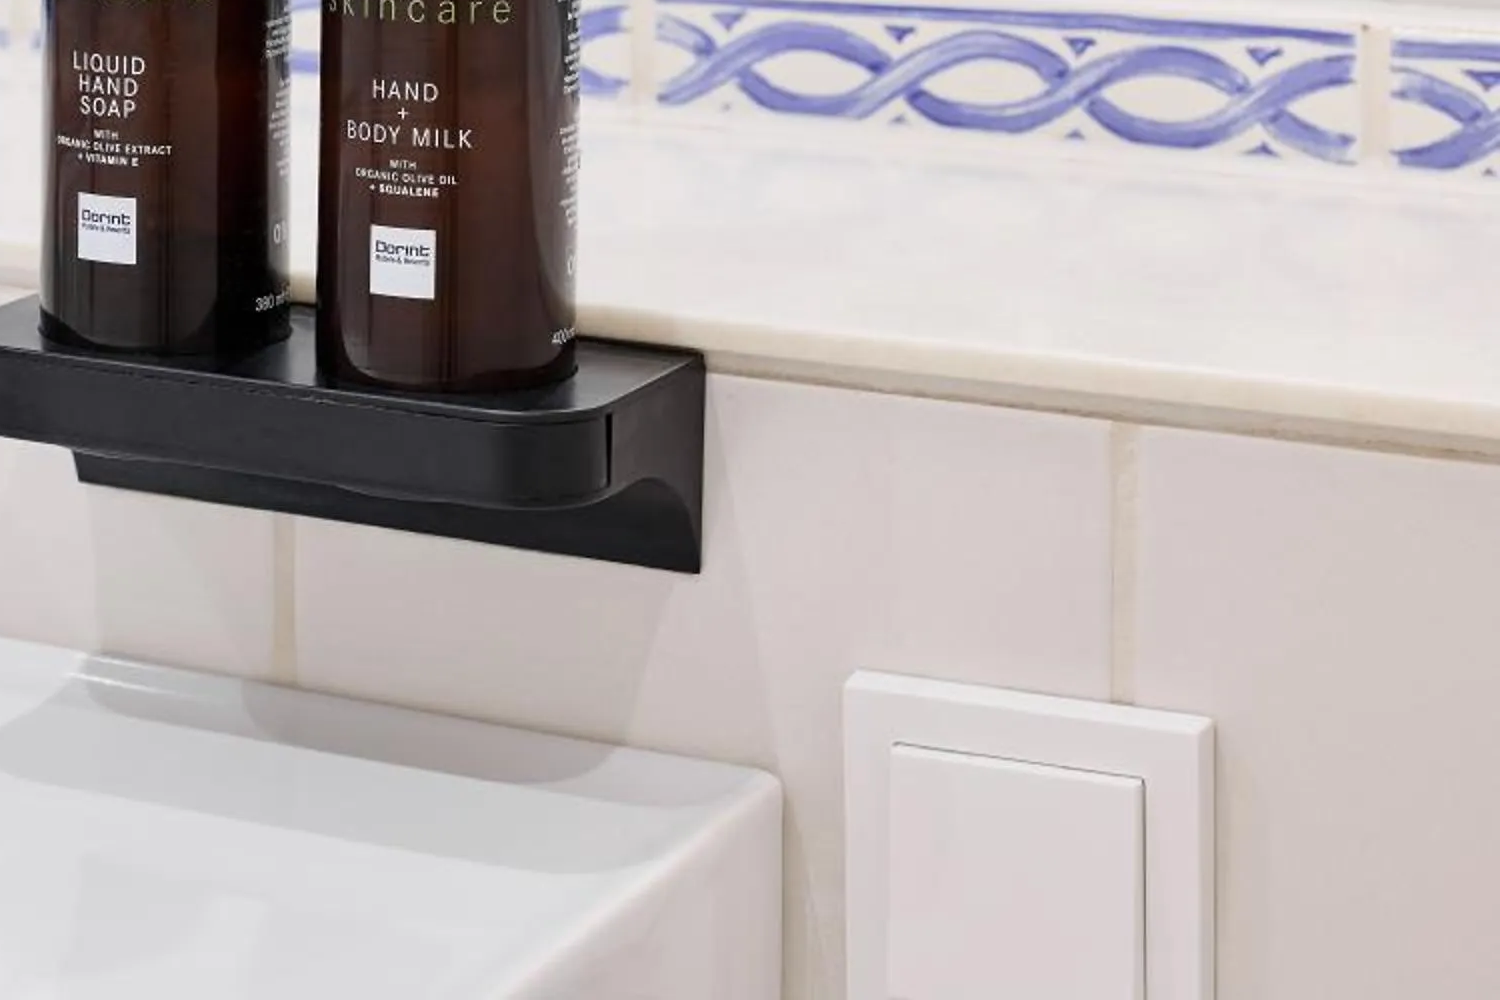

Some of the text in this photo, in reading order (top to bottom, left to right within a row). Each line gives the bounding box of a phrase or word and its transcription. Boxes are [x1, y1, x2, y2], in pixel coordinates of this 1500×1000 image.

[72, 50, 147, 76] LIQUID
[78, 73, 139, 98] HAND
[372, 79, 439, 103] HAND
[80, 96, 137, 119] SOAP
[93, 128, 119, 140] WITH
[347, 119, 473, 149] BODY MILK
[93, 141, 121, 153] OLIVE
[125, 144, 173, 155] EXTRACT
[85, 152, 129, 166] VITAMIN
[131, 157, 139, 167] E
[389, 159, 417, 170] WITH
[355, 167, 458, 185] ORGANIC OLIVE OIL
[379, 183, 439, 198] SQUALENE
[375, 240, 431, 257] Dorint
